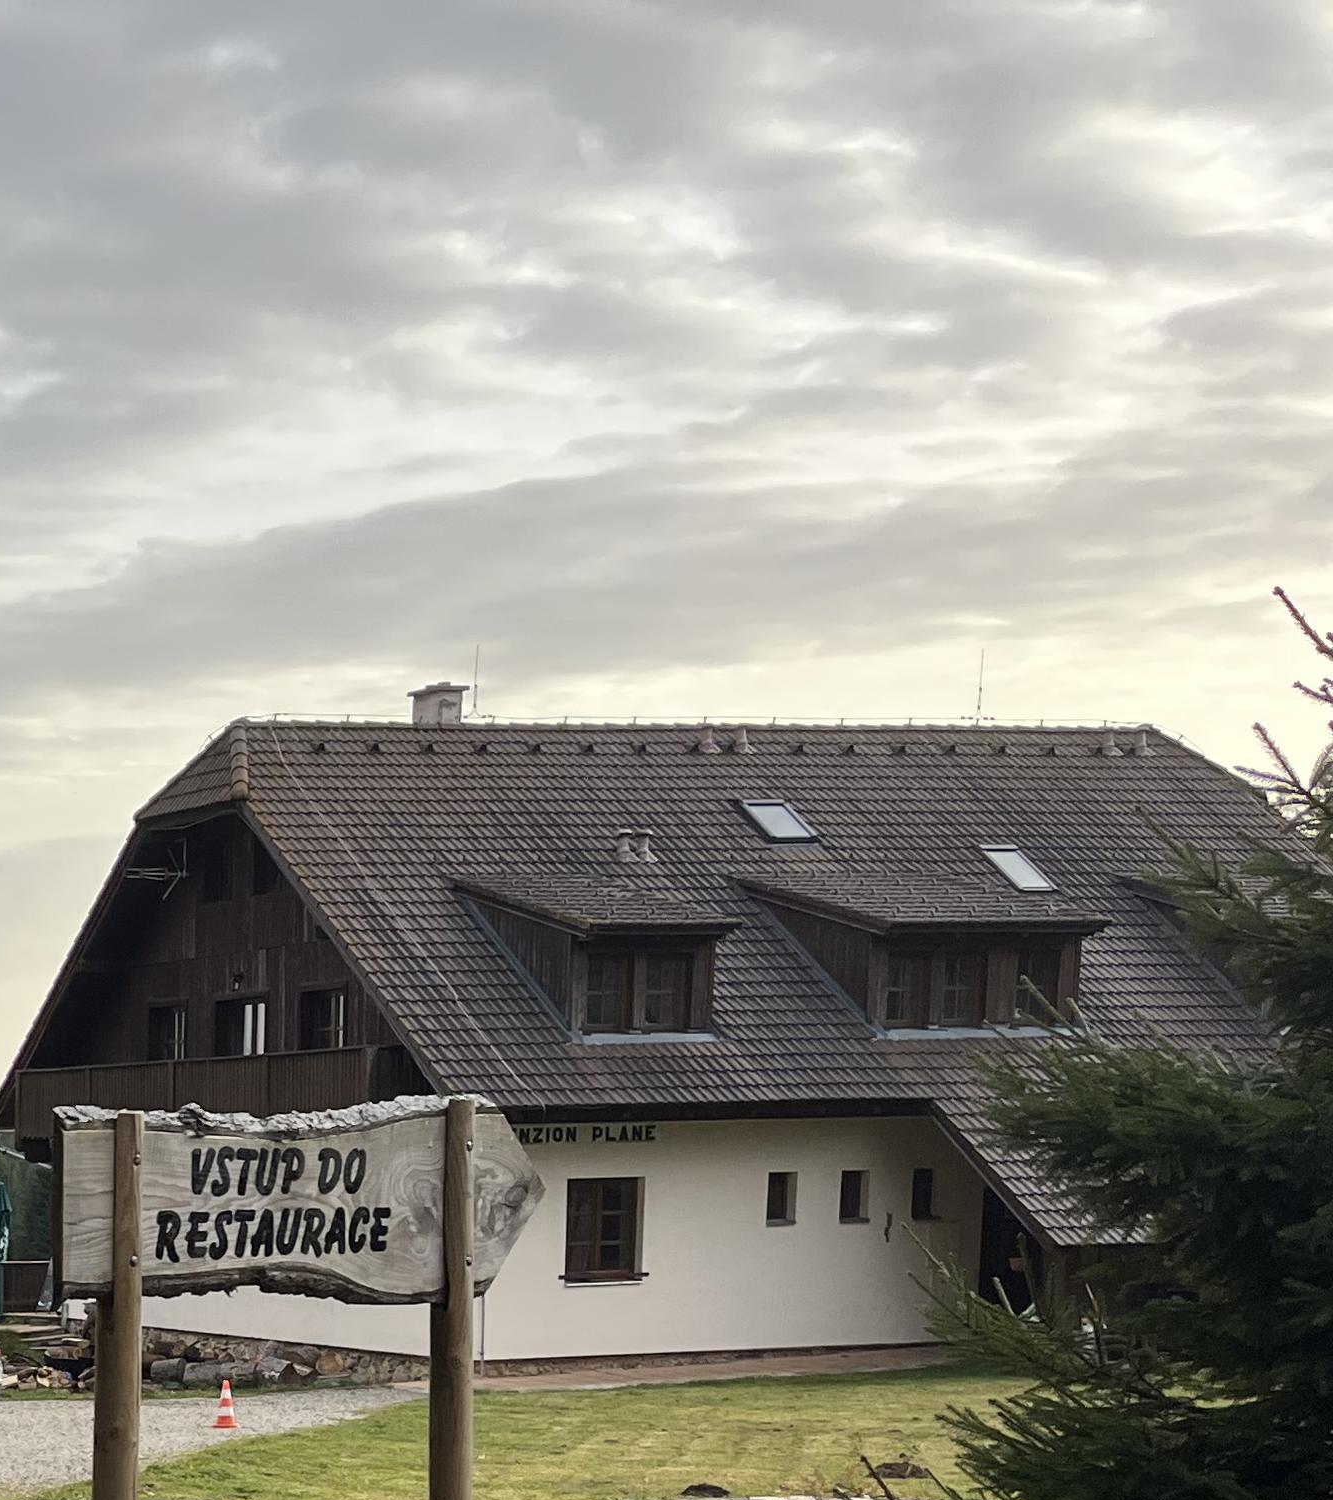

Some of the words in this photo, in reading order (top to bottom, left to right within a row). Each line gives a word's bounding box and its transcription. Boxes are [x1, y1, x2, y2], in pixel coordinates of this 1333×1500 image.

[513, 1127, 577, 1144] NZION
[191, 1146, 306, 1197] VSTUP
[317, 1148, 367, 1195] DO
[155, 1207, 392, 1263] RESTAURACE
